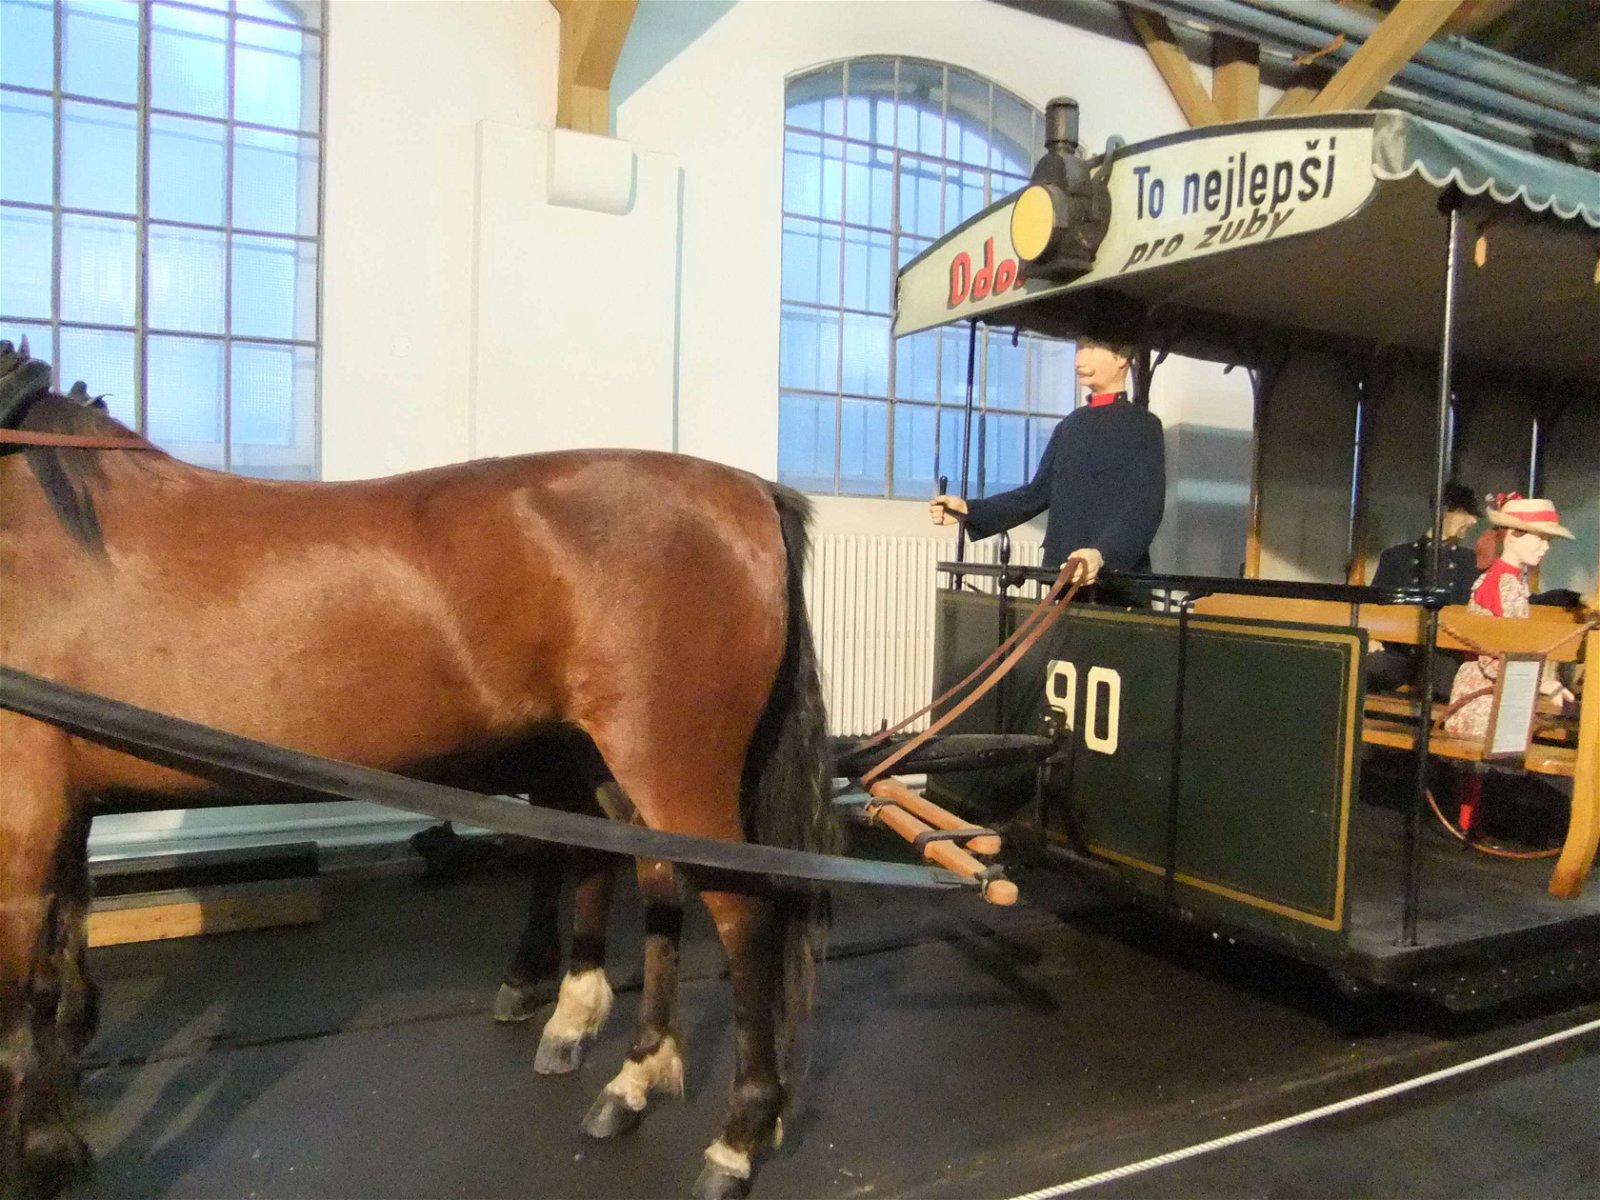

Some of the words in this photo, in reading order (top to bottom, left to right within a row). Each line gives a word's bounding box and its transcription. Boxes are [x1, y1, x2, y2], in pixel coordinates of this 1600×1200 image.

[1133, 165, 1165, 220] To
[947, 236, 1025, 310] Odo
[1120, 233, 1184, 272] pro
[1194, 207, 1296, 250] zuby
[1045, 659, 1121, 755] 90
